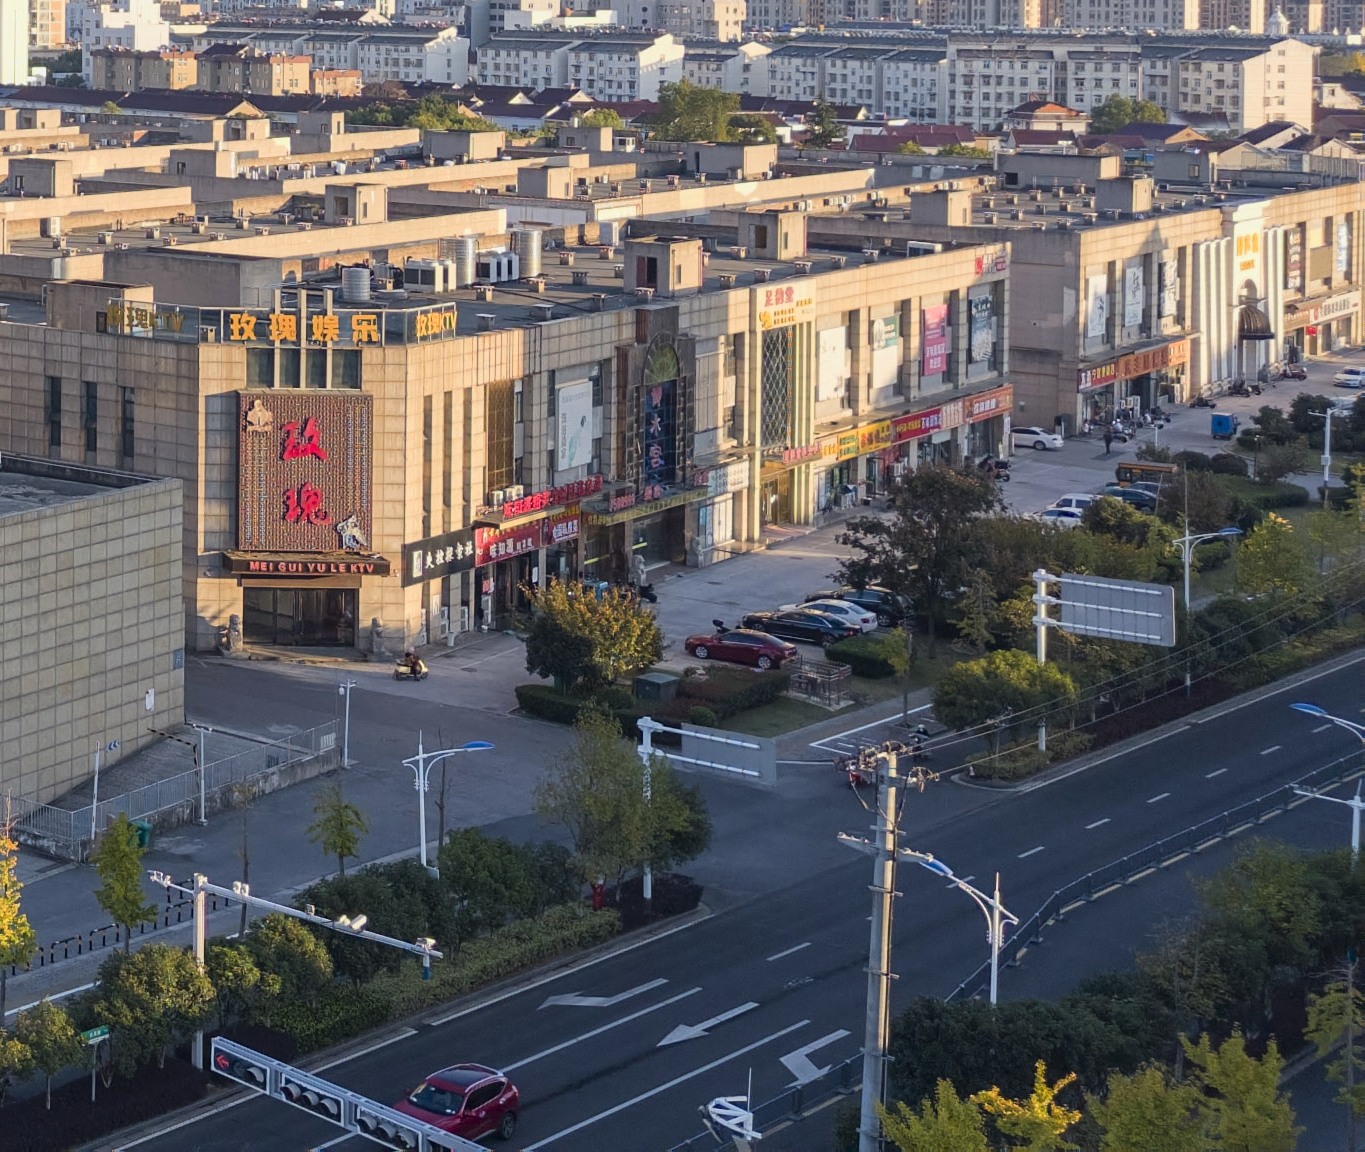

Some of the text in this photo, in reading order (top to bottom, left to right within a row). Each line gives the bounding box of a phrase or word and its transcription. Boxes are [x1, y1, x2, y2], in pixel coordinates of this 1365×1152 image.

[229, 312, 379, 342] 玫瑰娱乐
[415, 311, 459, 337] 玫瑰KTV
[281, 416, 330, 527] 玫瑰
[249, 561, 374, 574] MEI GUI YU LE KTV
